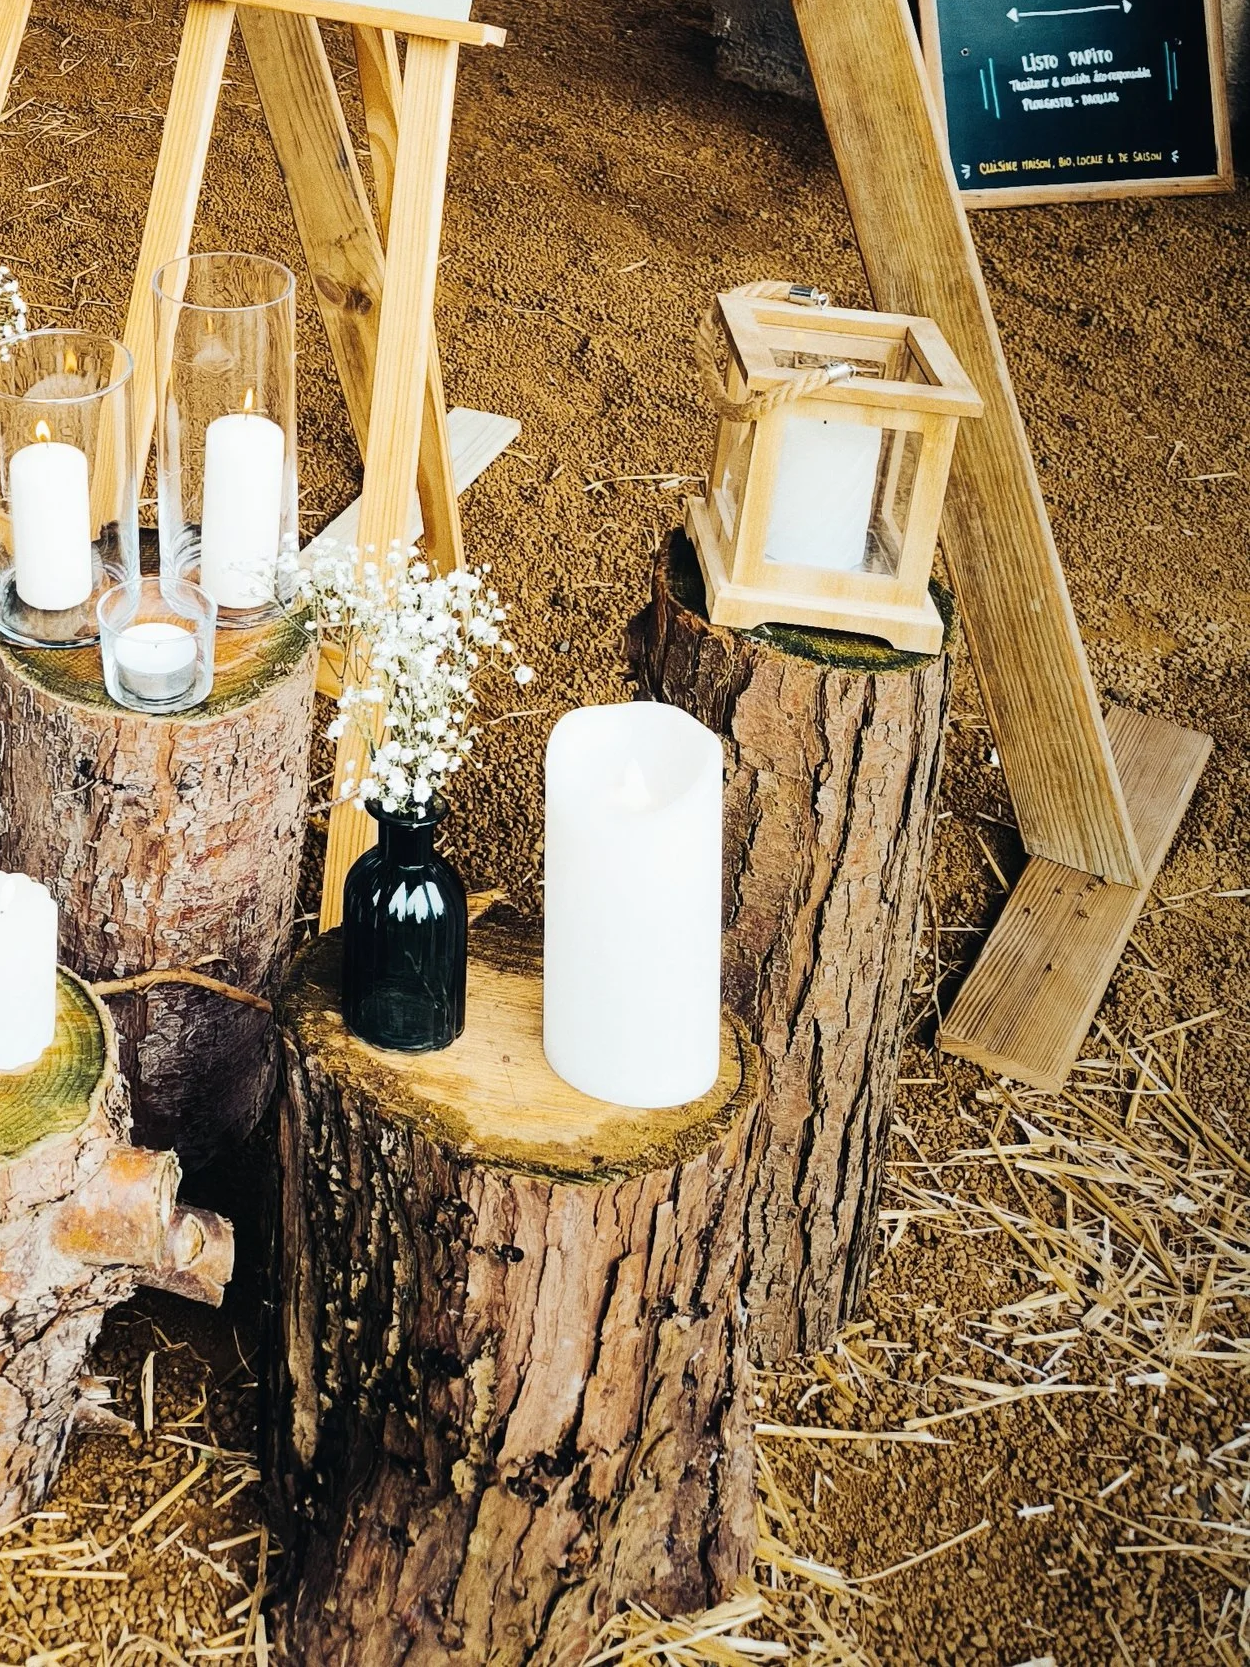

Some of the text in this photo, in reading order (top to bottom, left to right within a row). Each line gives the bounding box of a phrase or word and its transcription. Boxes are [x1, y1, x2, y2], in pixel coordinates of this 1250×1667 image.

[1076, 154, 1103, 166] LOCALE
[1106, 154, 1114, 164] &
[1117, 152, 1129, 163] DE
